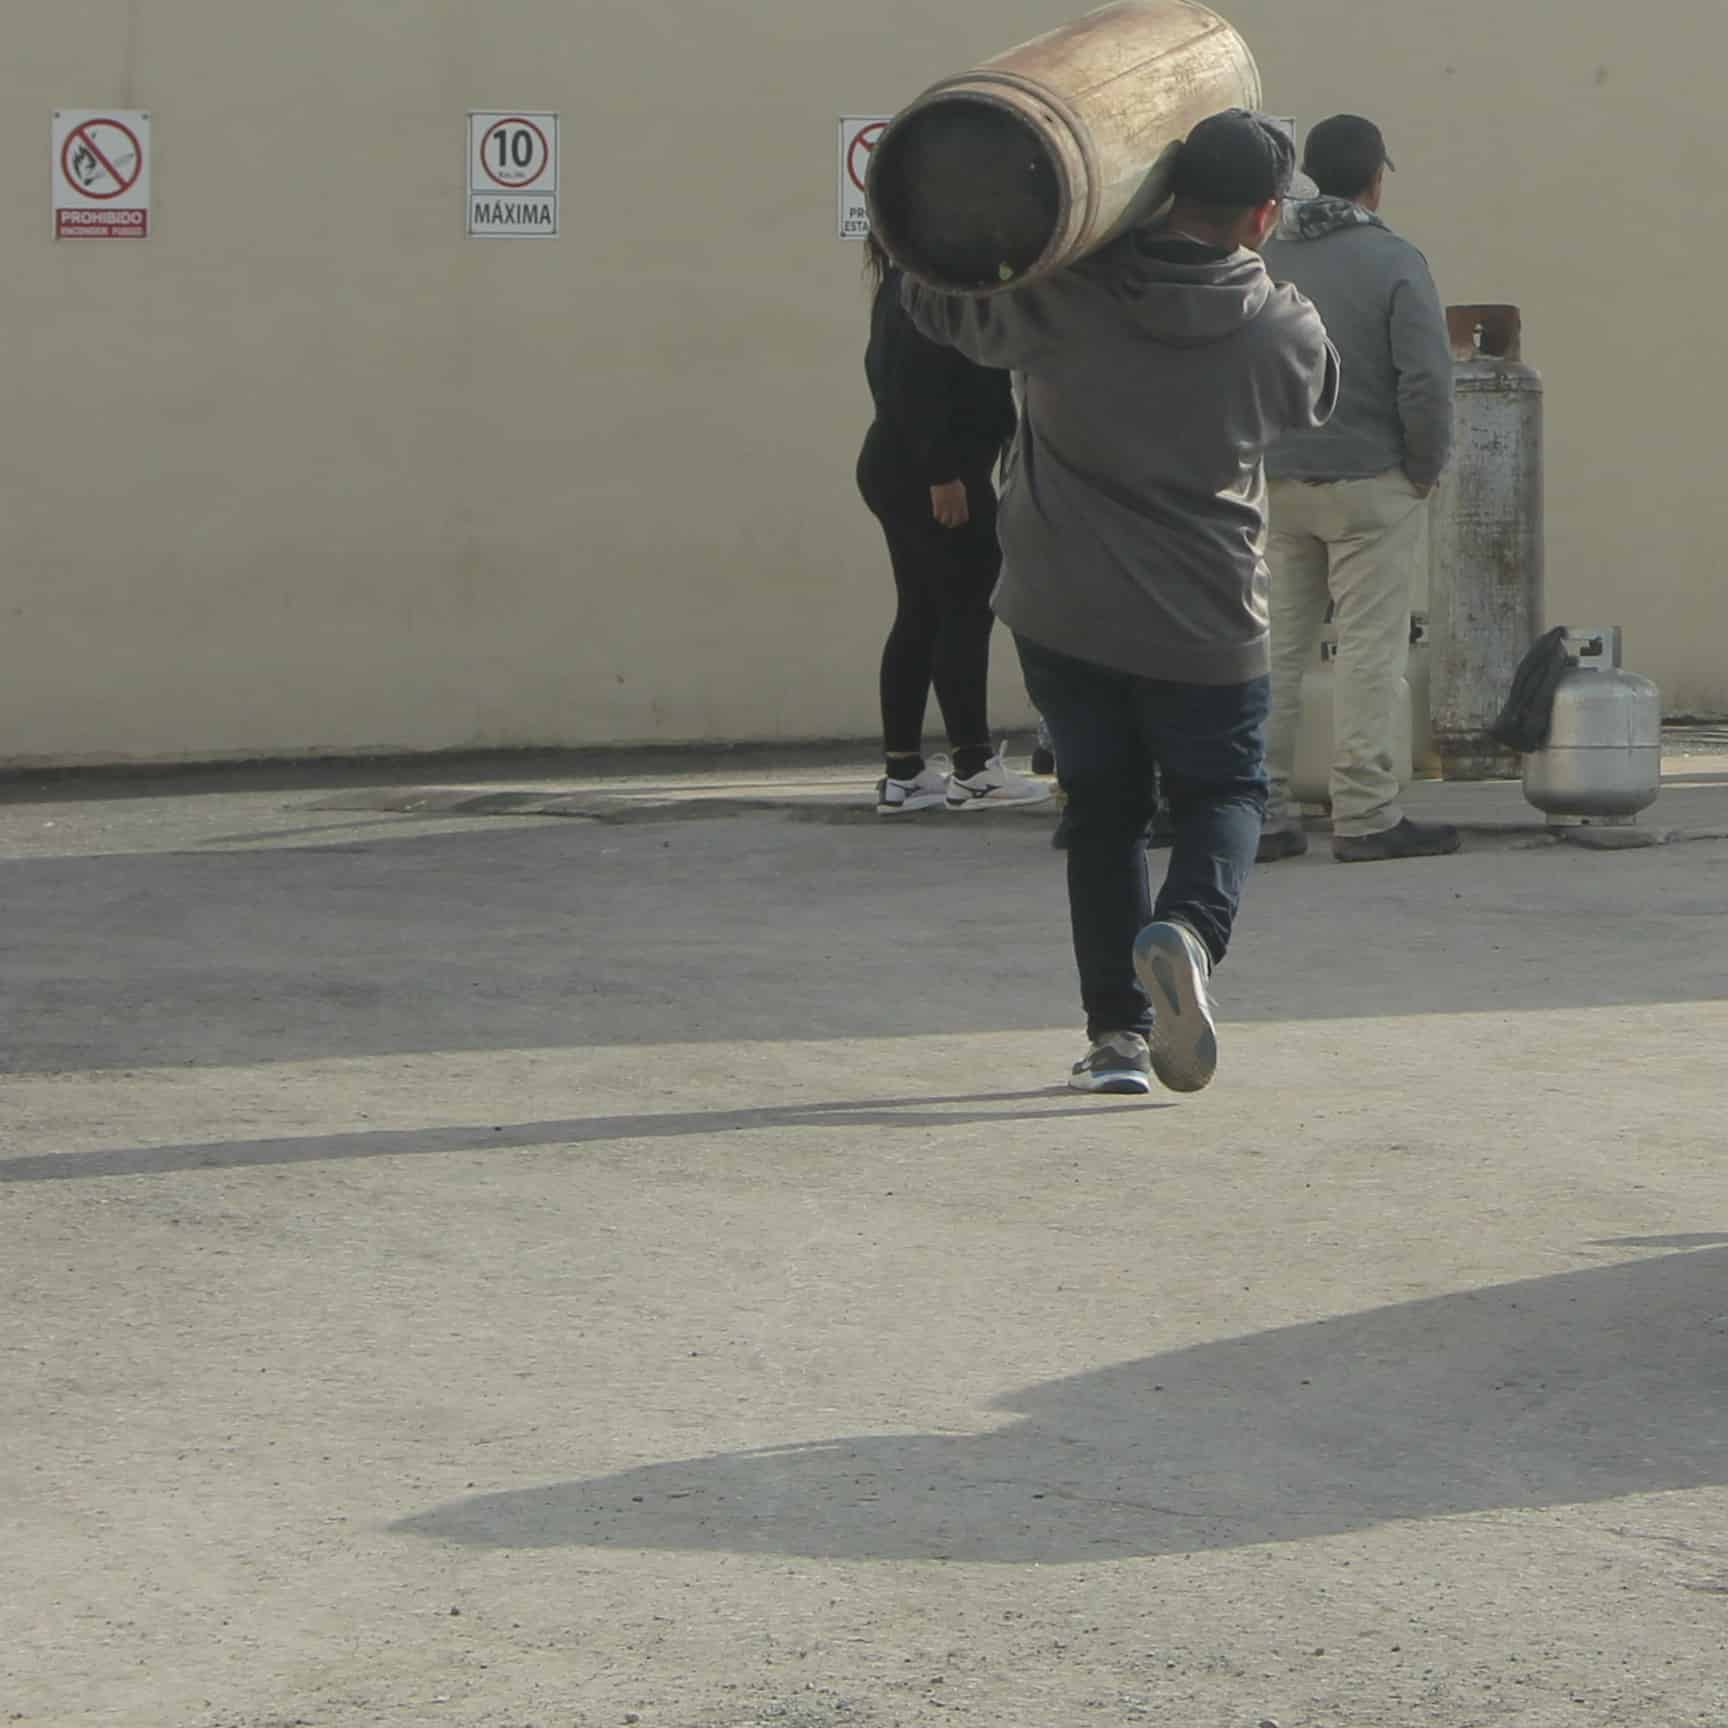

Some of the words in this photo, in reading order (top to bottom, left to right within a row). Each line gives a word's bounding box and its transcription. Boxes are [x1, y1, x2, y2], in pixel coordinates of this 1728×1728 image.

[493, 129, 533, 167] 10
[61, 211, 143, 225] PROHIBIDO
[474, 200, 552, 225] MÁXIMA
